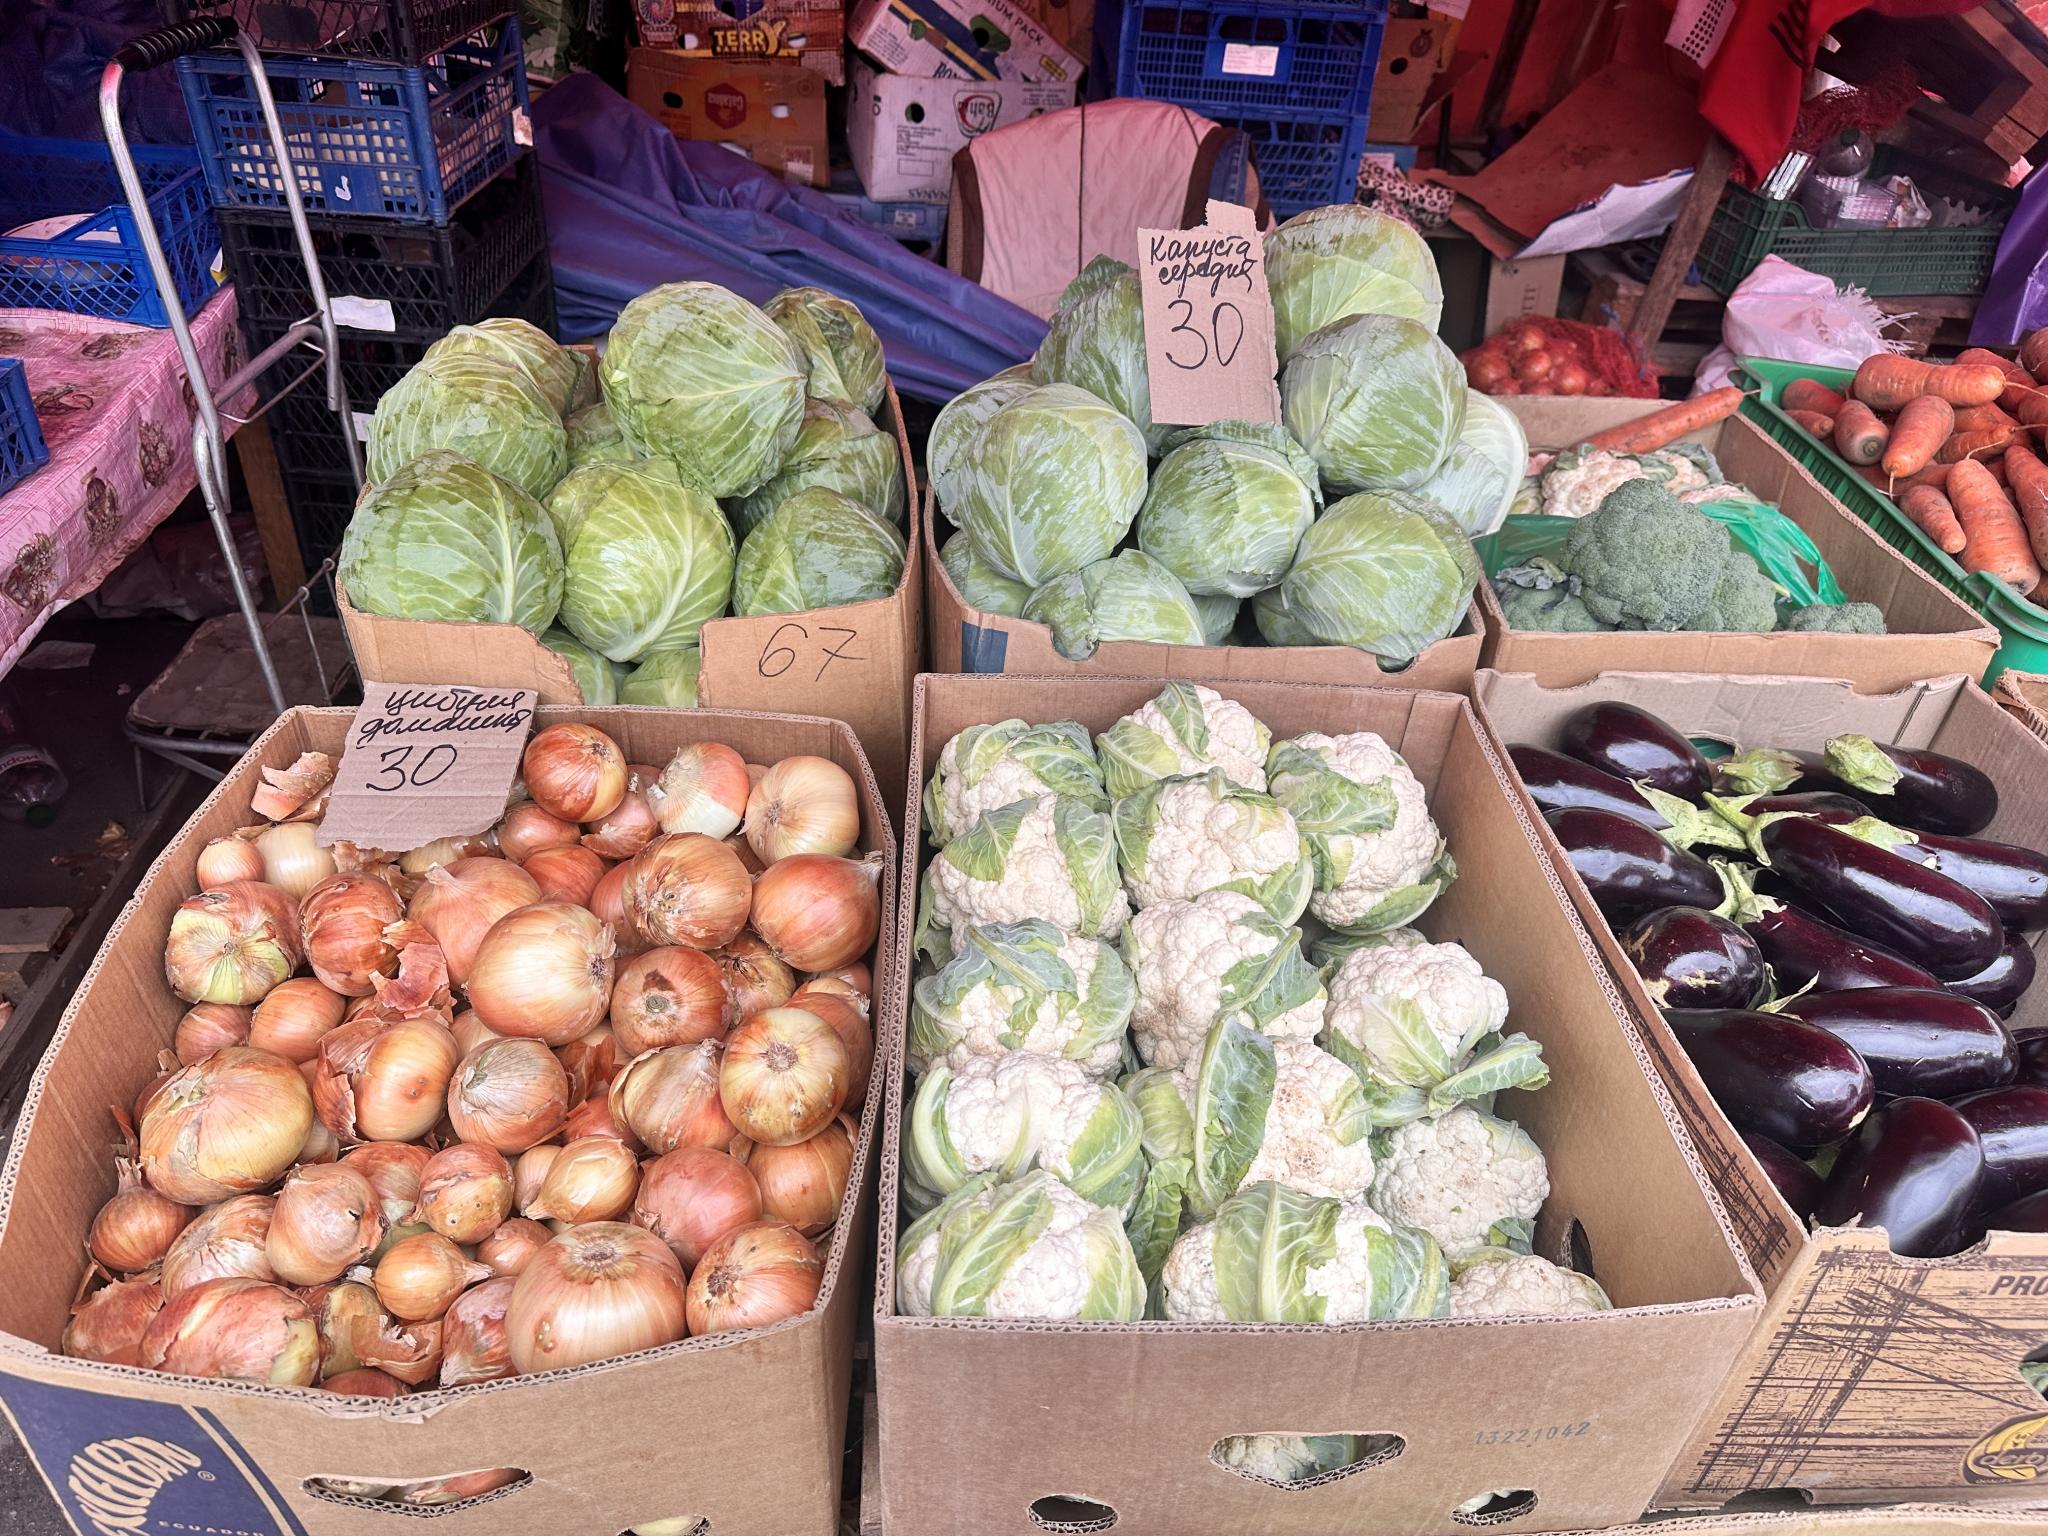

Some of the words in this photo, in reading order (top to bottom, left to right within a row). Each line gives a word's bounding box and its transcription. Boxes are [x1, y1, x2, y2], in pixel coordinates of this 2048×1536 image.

[713, 21, 787, 54] TERRY
[1014, 17, 1045, 46] PACK
[1165, 299, 1244, 370] 30
[758, 623, 870, 682] 67
[365, 744, 458, 791] 30
